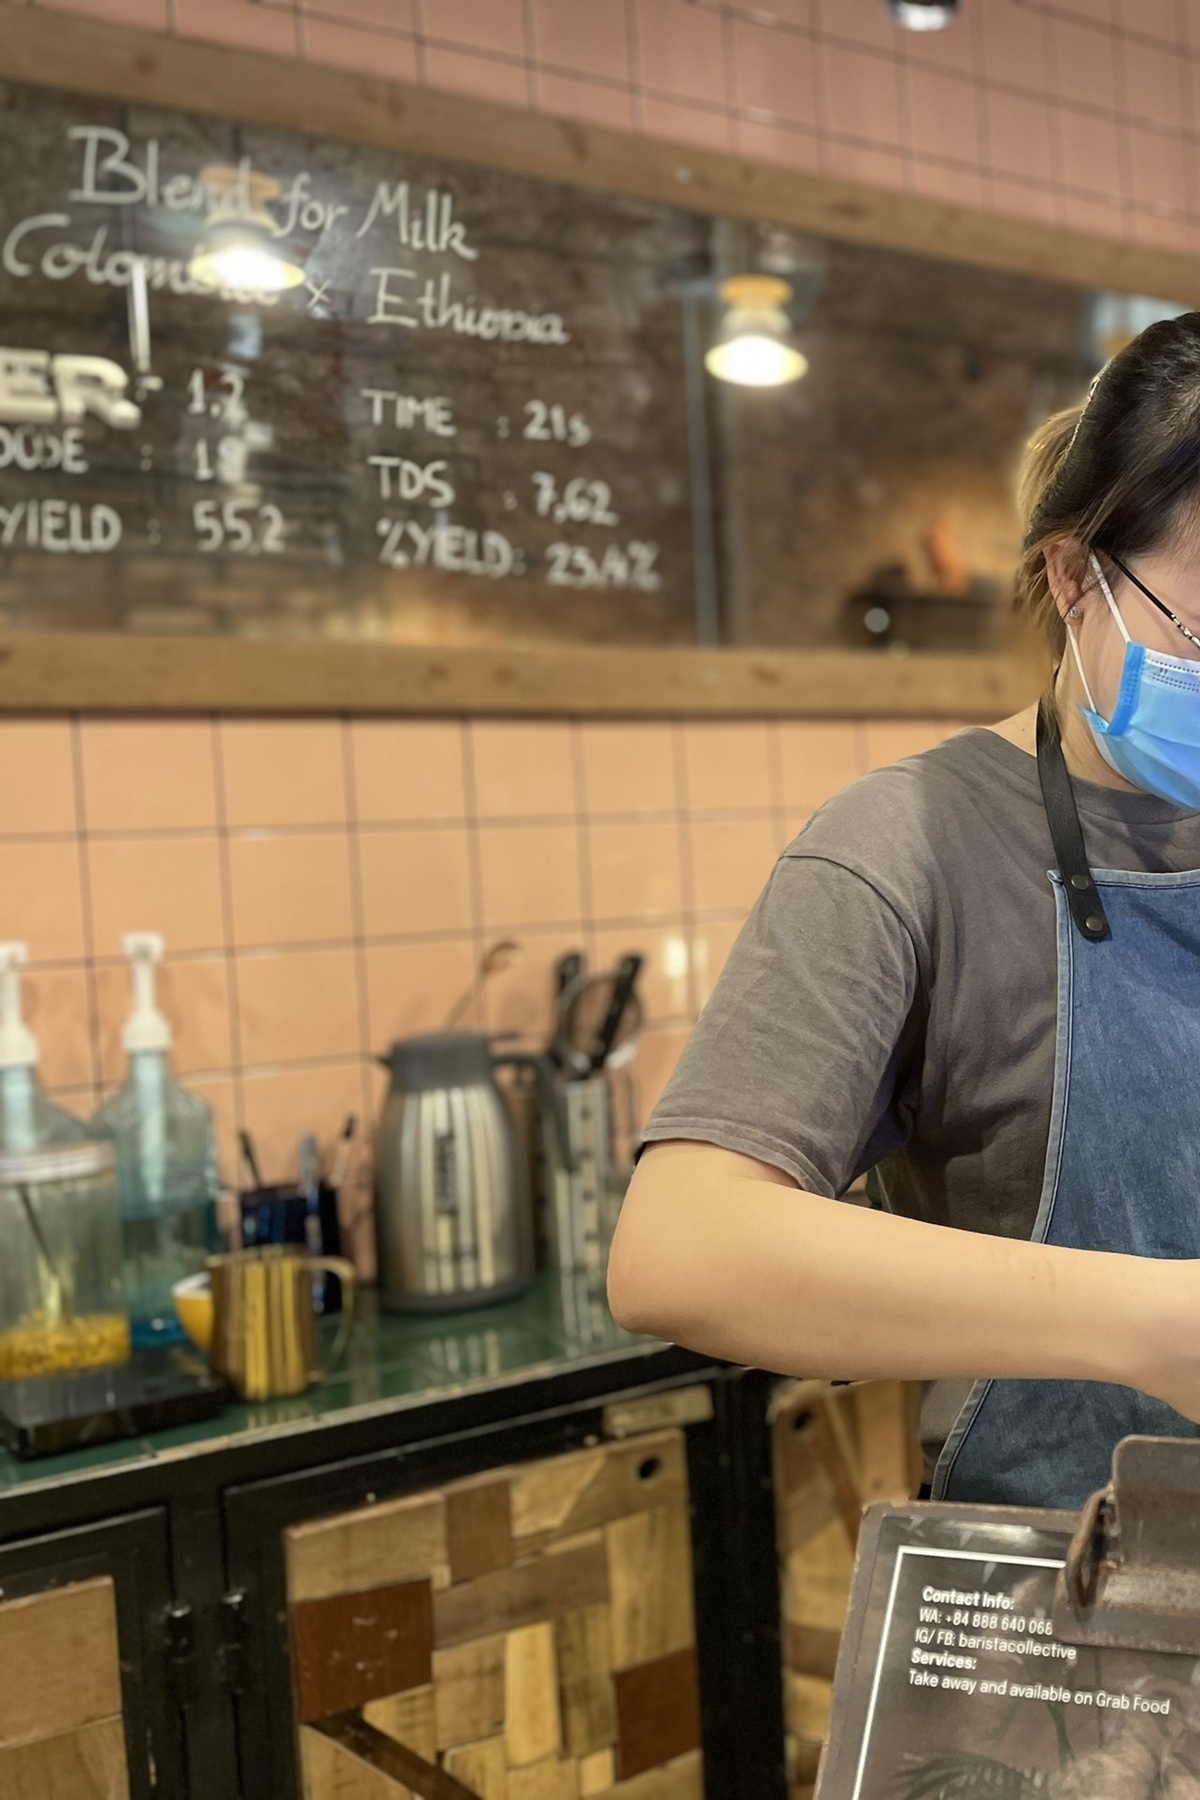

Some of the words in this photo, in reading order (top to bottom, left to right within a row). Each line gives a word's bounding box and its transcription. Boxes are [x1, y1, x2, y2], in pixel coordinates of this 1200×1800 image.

[67, 125, 252, 222] Blend
[272, 170, 348, 238] for
[356, 180, 479, 261] Milk
[360, 388, 457, 437] TIME
[366, 455, 455, 508] TDS
[0, 499, 122, 552] YIELD
[919, 1607, 942, 1624] WA:
[945, 1610, 969, 1627] +84
[972, 1612, 998, 1629] 888
[1001, 1615, 1026, 1633] 640
[922, 1585, 980, 1607] Contact
[982, 1592, 1014, 1610] Info:
[911, 1647, 977, 1670] Services:
[915, 1627, 933, 1645] IG/
[936, 1629, 955, 1646] FB:
[958, 1631, 1077, 1660] baristacollective
[909, 1669, 939, 1687] Take
[941, 1674, 977, 1695] away
[980, 1679, 1008, 1695] and
[1009, 1684, 1071, 1703] available
[1074, 1692, 1093, 1705] on
[1096, 1691, 1130, 1710] Grab
[1133, 1696, 1171, 1715] Food
